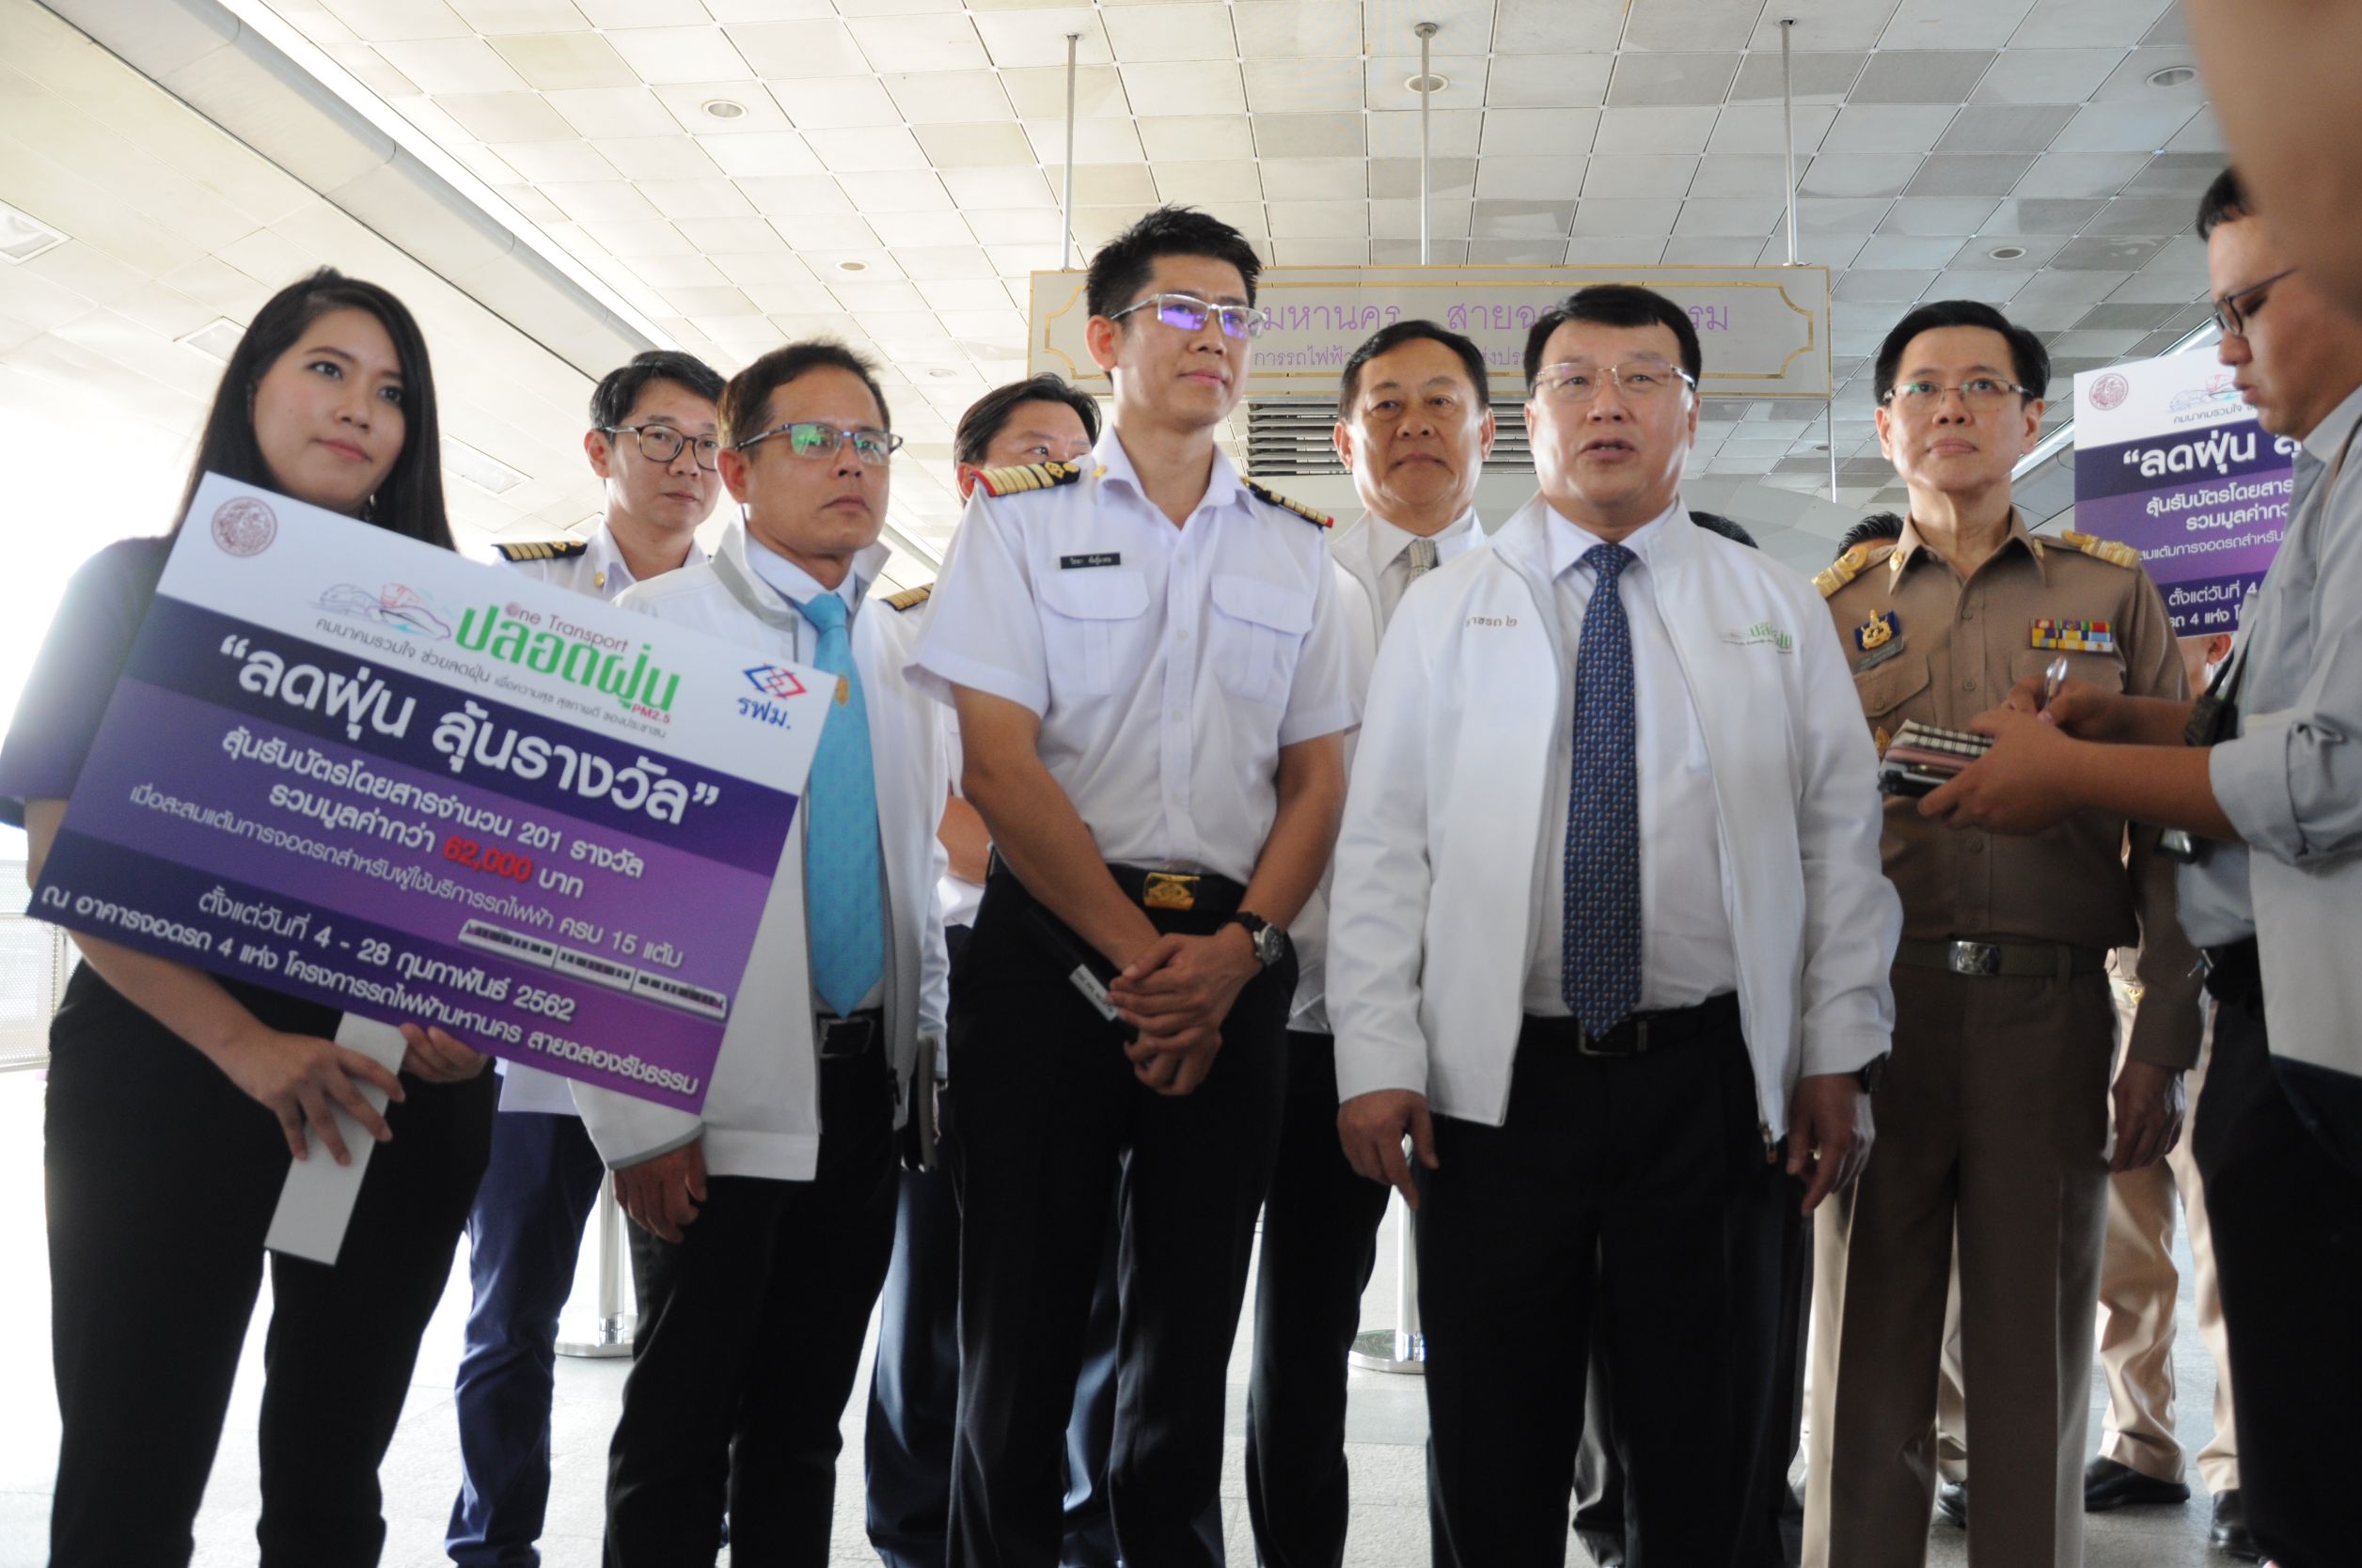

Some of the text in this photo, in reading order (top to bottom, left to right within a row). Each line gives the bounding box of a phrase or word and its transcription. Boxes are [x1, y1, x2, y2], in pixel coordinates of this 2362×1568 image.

[316, 618, 416, 658] คมนาคมรวมใจ
[550, 614, 628, 652] Transport
[2190, 613, 2198, 625] 4
[455, 604, 681, 712] ปลอดฝุ่น
[631, 703, 670, 724] PM2.5
[738, 698, 791, 729] รฟม.
[269, 783, 584, 899] รวมมูลค่ากว่า 62,000 บาท
[517, 822, 561, 853] 201
[570, 839, 645, 879] รางวัล
[198, 885, 311, 941] ตั้งแต่วันที่
[314, 925, 332, 949] 4
[357, 939, 392, 966] 28
[397, 951, 512, 1002] กุมภาพันธ์
[513, 985, 576, 1022] 2562
[559, 917, 603, 944] ครบ
[612, 932, 638, 955] 15
[642, 937, 683, 969] แต้ม
[41, 885, 699, 1095] ณ อาคารจอดรถ 4 แห่ง โครงการรถไฟฟ้ามหานคร สายฉลองรัชธรรม
